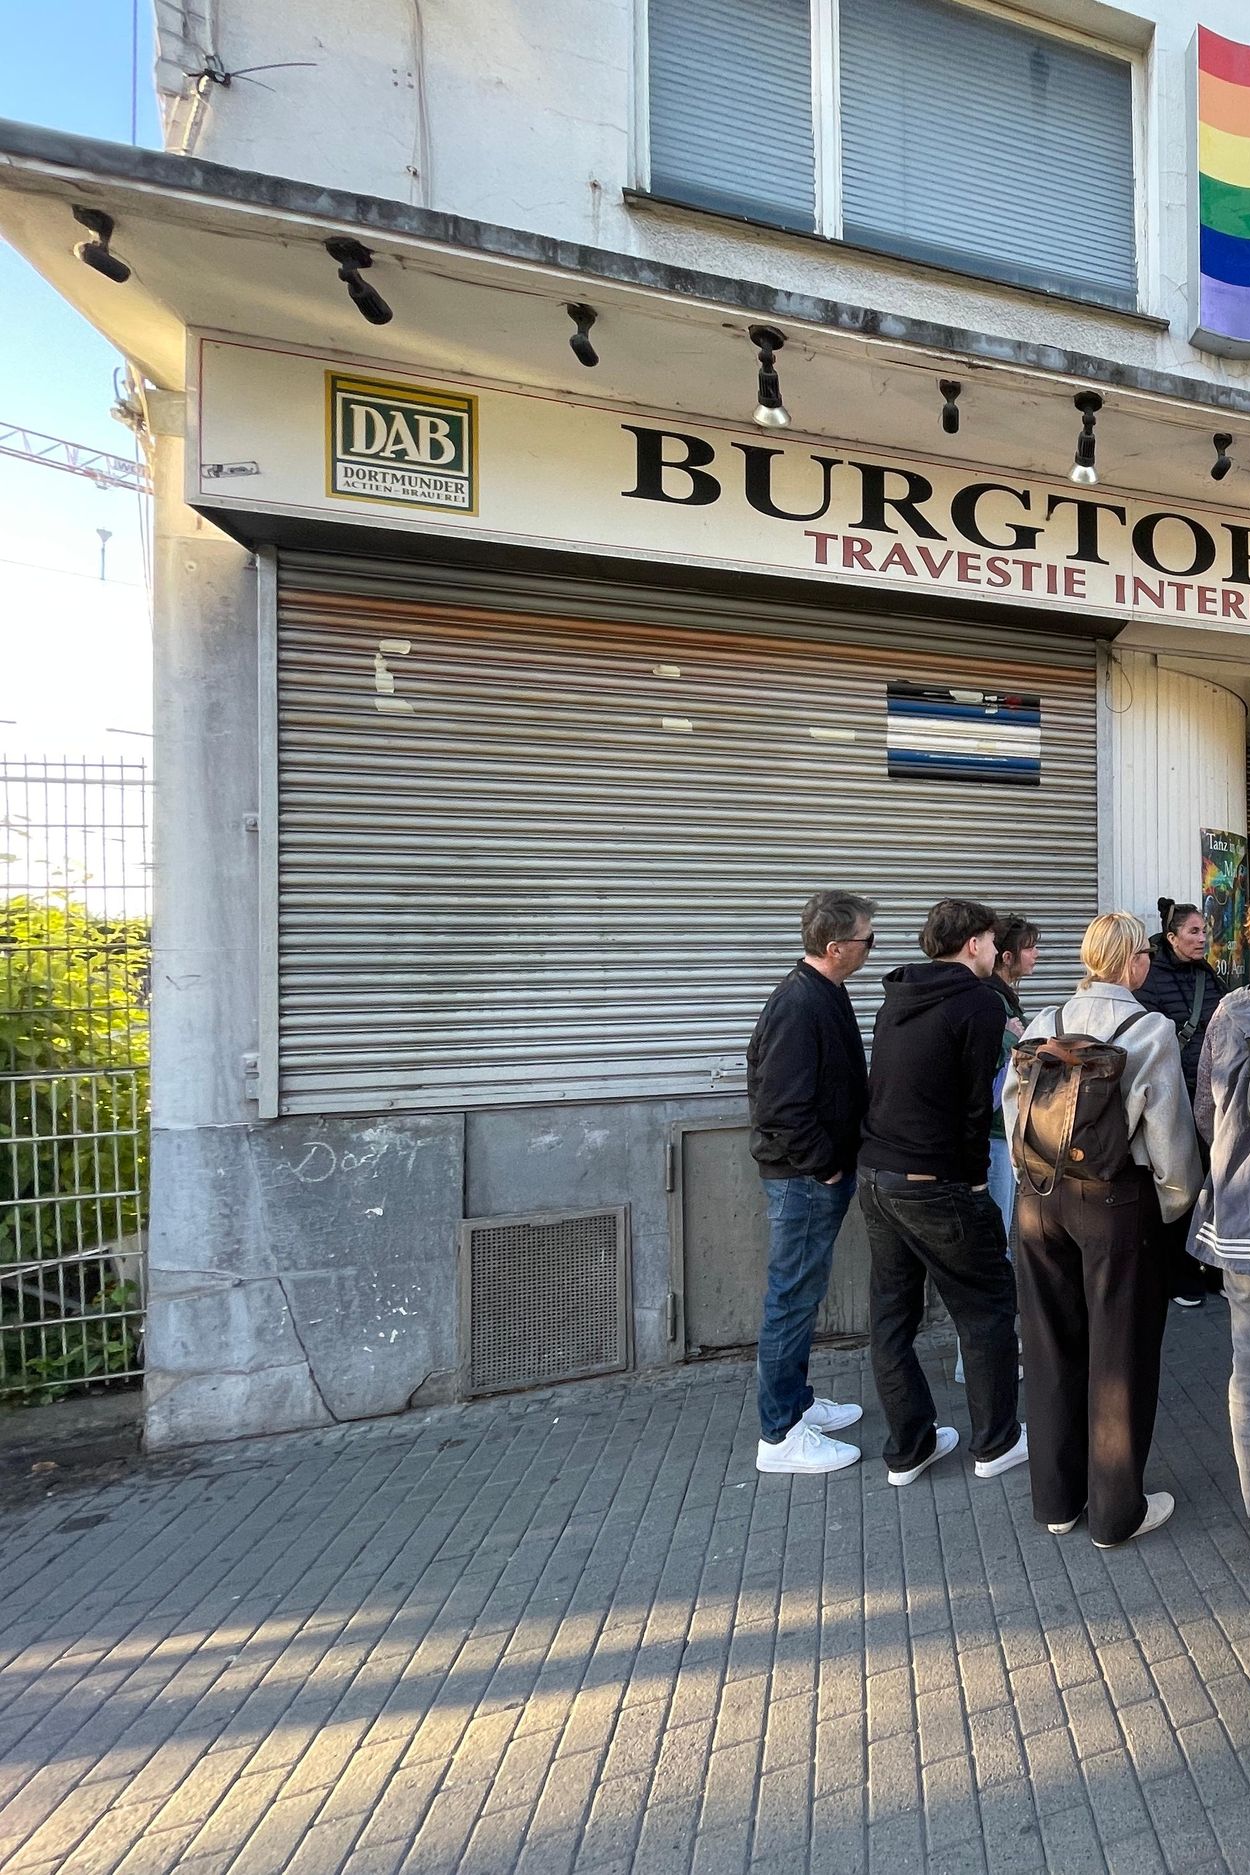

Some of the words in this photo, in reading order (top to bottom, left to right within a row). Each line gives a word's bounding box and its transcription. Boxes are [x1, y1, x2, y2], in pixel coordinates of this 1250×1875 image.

[350, 404, 456, 465] DAB
[343, 466, 465, 495] DORTMUNDER
[804, 530, 1087, 599] TRAVESTIE
[1206, 832, 1228, 852] Tanz
